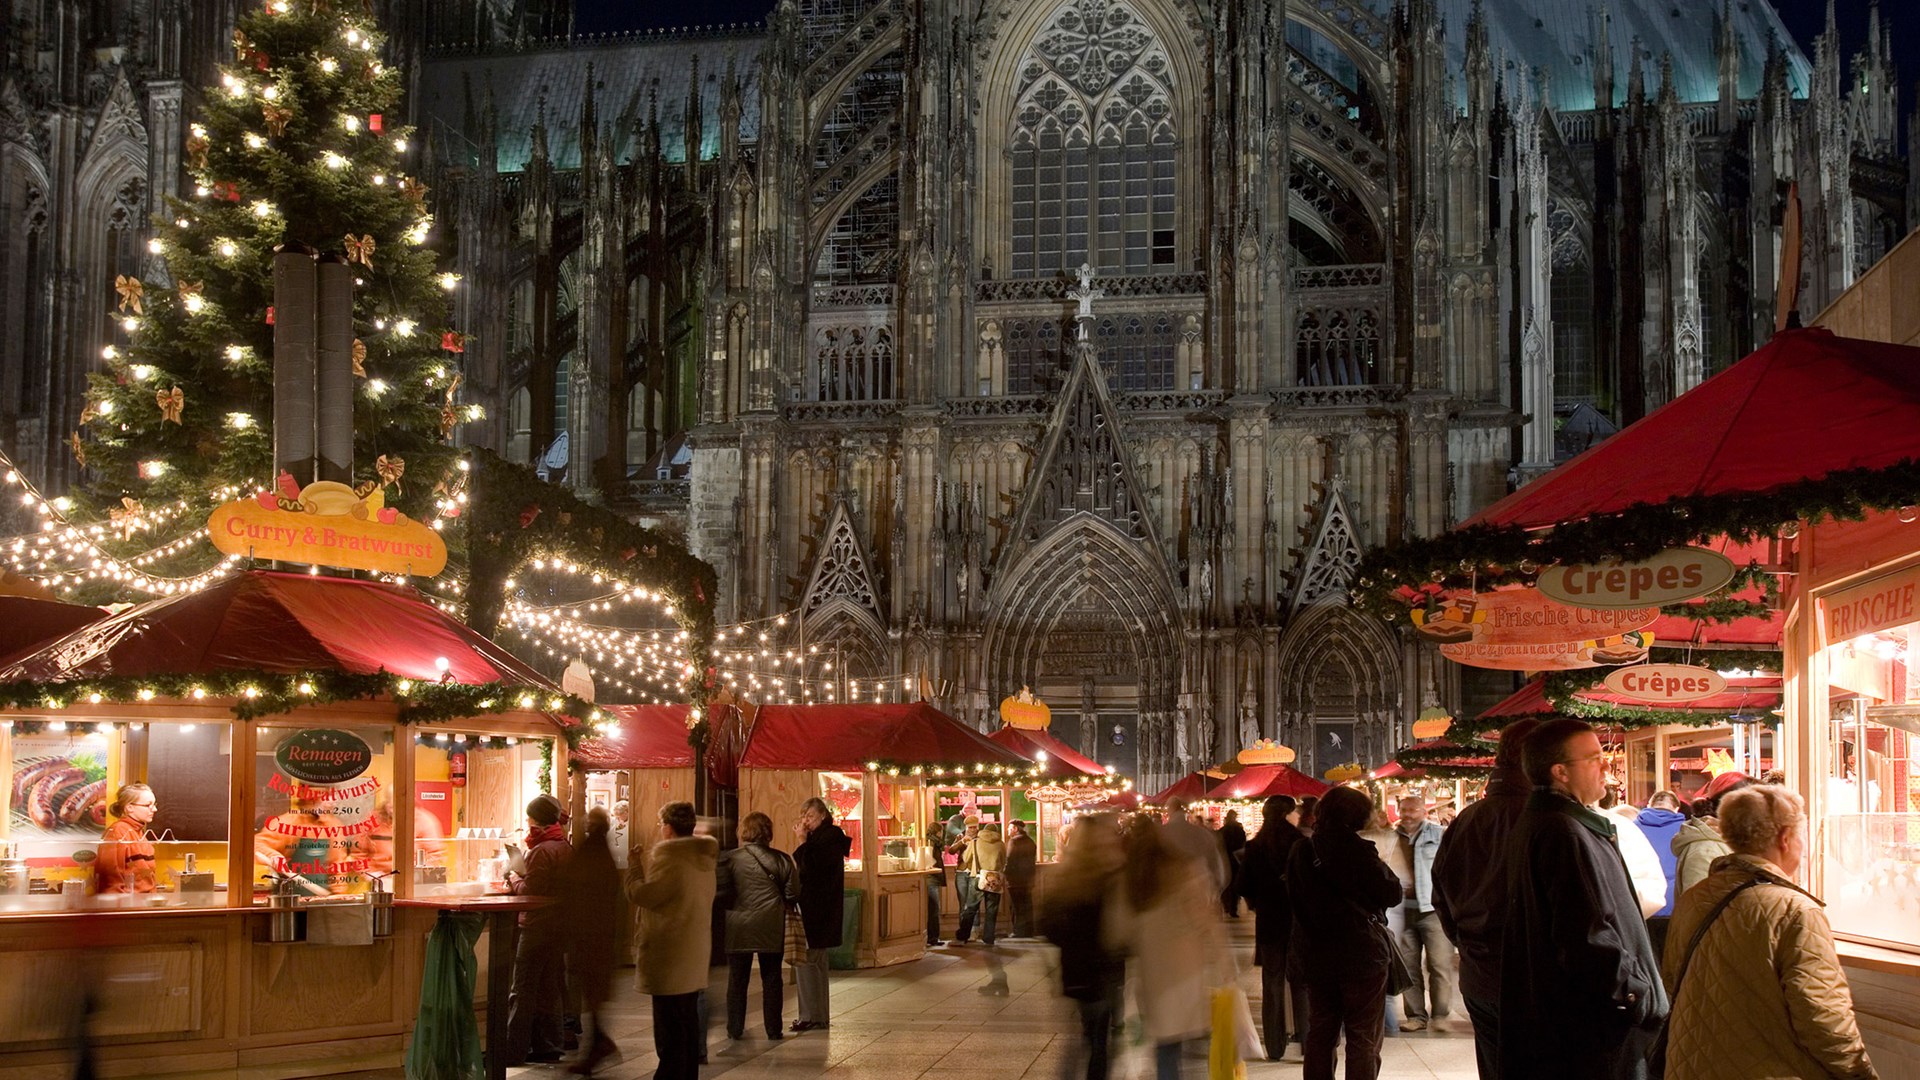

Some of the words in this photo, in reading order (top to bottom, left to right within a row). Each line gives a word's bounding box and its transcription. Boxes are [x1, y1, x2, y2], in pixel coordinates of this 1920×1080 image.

[226, 516, 297, 547] Curry
[303, 527, 318, 545] &
[323, 528, 433, 559] Bratwurst
[1562, 562, 1703, 600] Crêpes
[1493, 605, 1569, 628] Frische
[1831, 583, 1916, 639] FRISCHE
[1622, 672, 1710, 696] Crêpes
[288, 745, 363, 766] Remagen
[267, 772, 381, 802] Rostbratwurst
[333, 807, 353, 816] 2,50
[264, 814, 381, 843] Currywurst
[333, 840, 352, 849] 2,90
[276, 856, 373, 876] Krakauer
